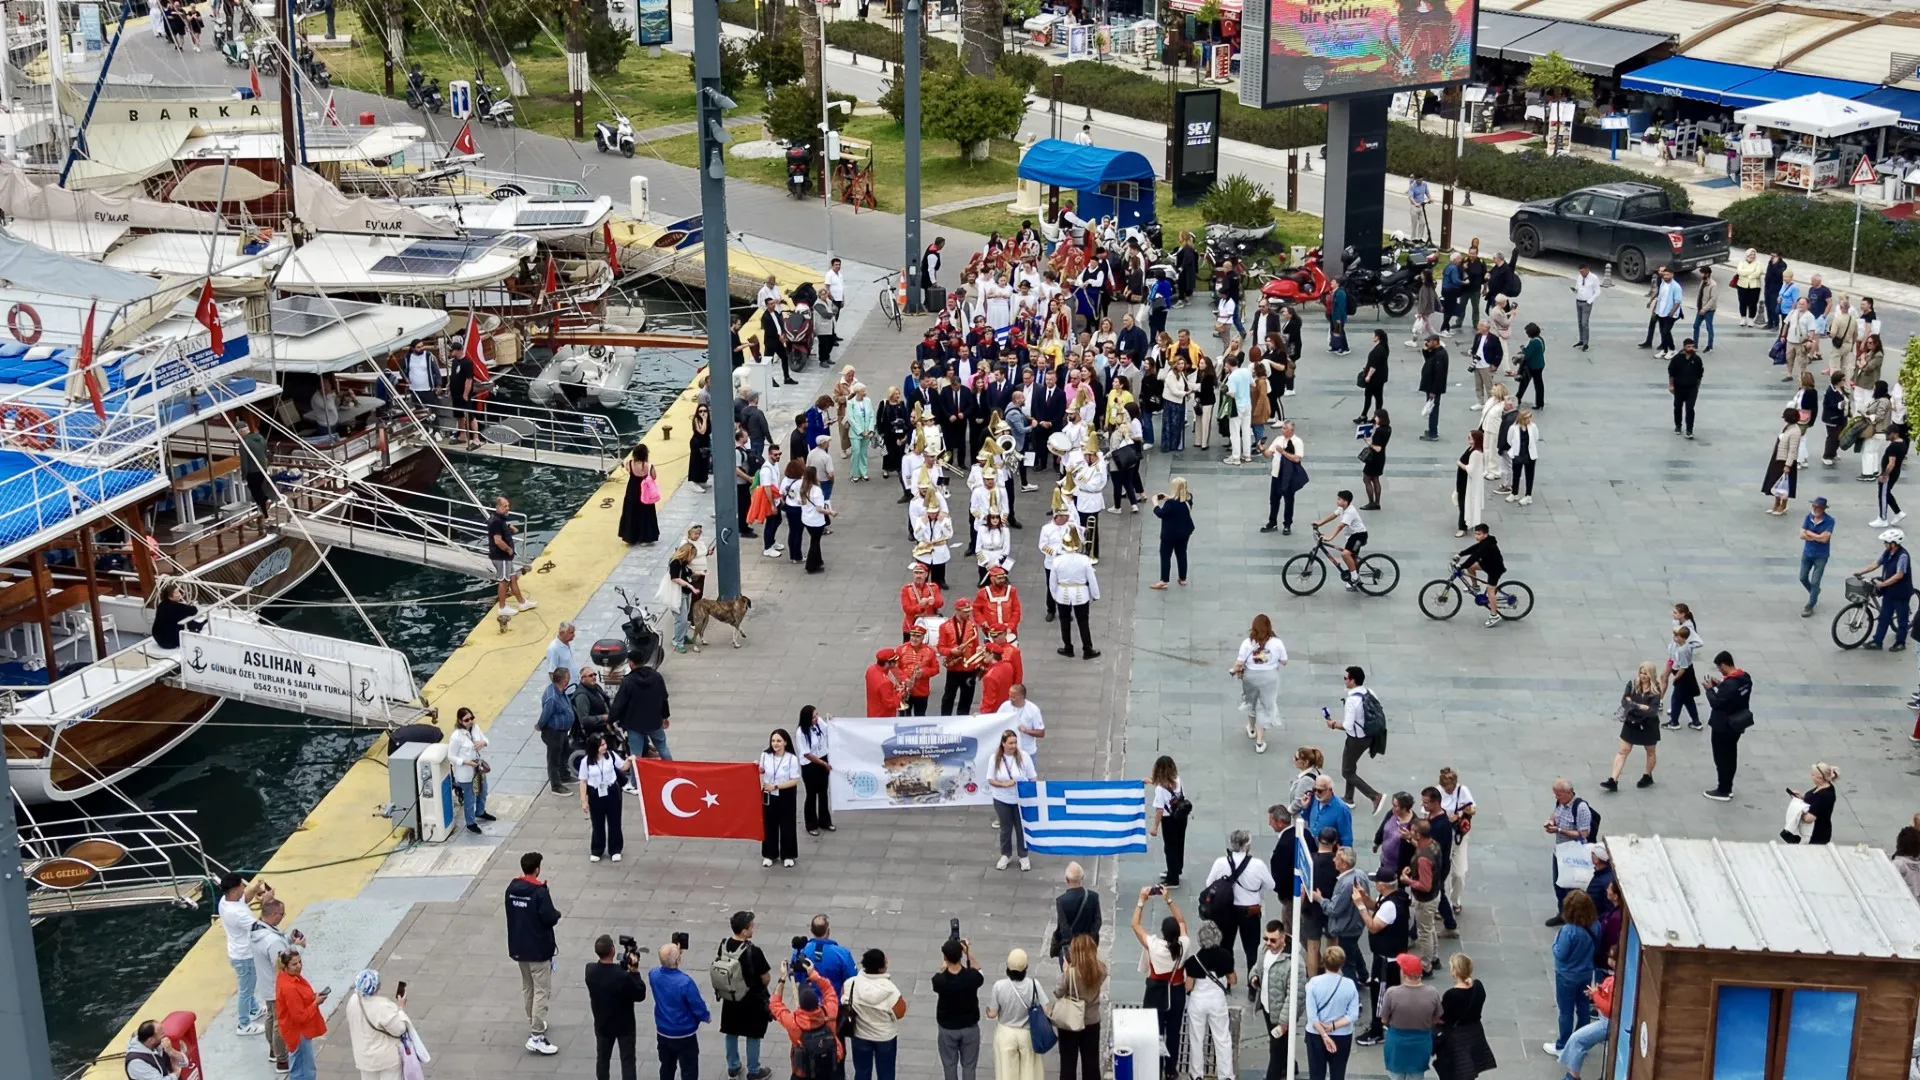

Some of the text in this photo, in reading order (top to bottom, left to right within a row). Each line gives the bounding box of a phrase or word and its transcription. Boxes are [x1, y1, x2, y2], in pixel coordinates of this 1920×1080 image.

[1300, 8, 1320, 24] bir
[129, 104, 261, 122] BARKA
[244, 651, 316, 677] ASLIHAN 4
[211, 663, 237, 676] GÜNLÜK
[239, 667, 256, 679] ÖZEL
[258, 672, 285, 684] TURLAR
[253, 682, 271, 692] 0542
[273, 686, 286, 695] 511
[40, 872, 56, 880] GEL
